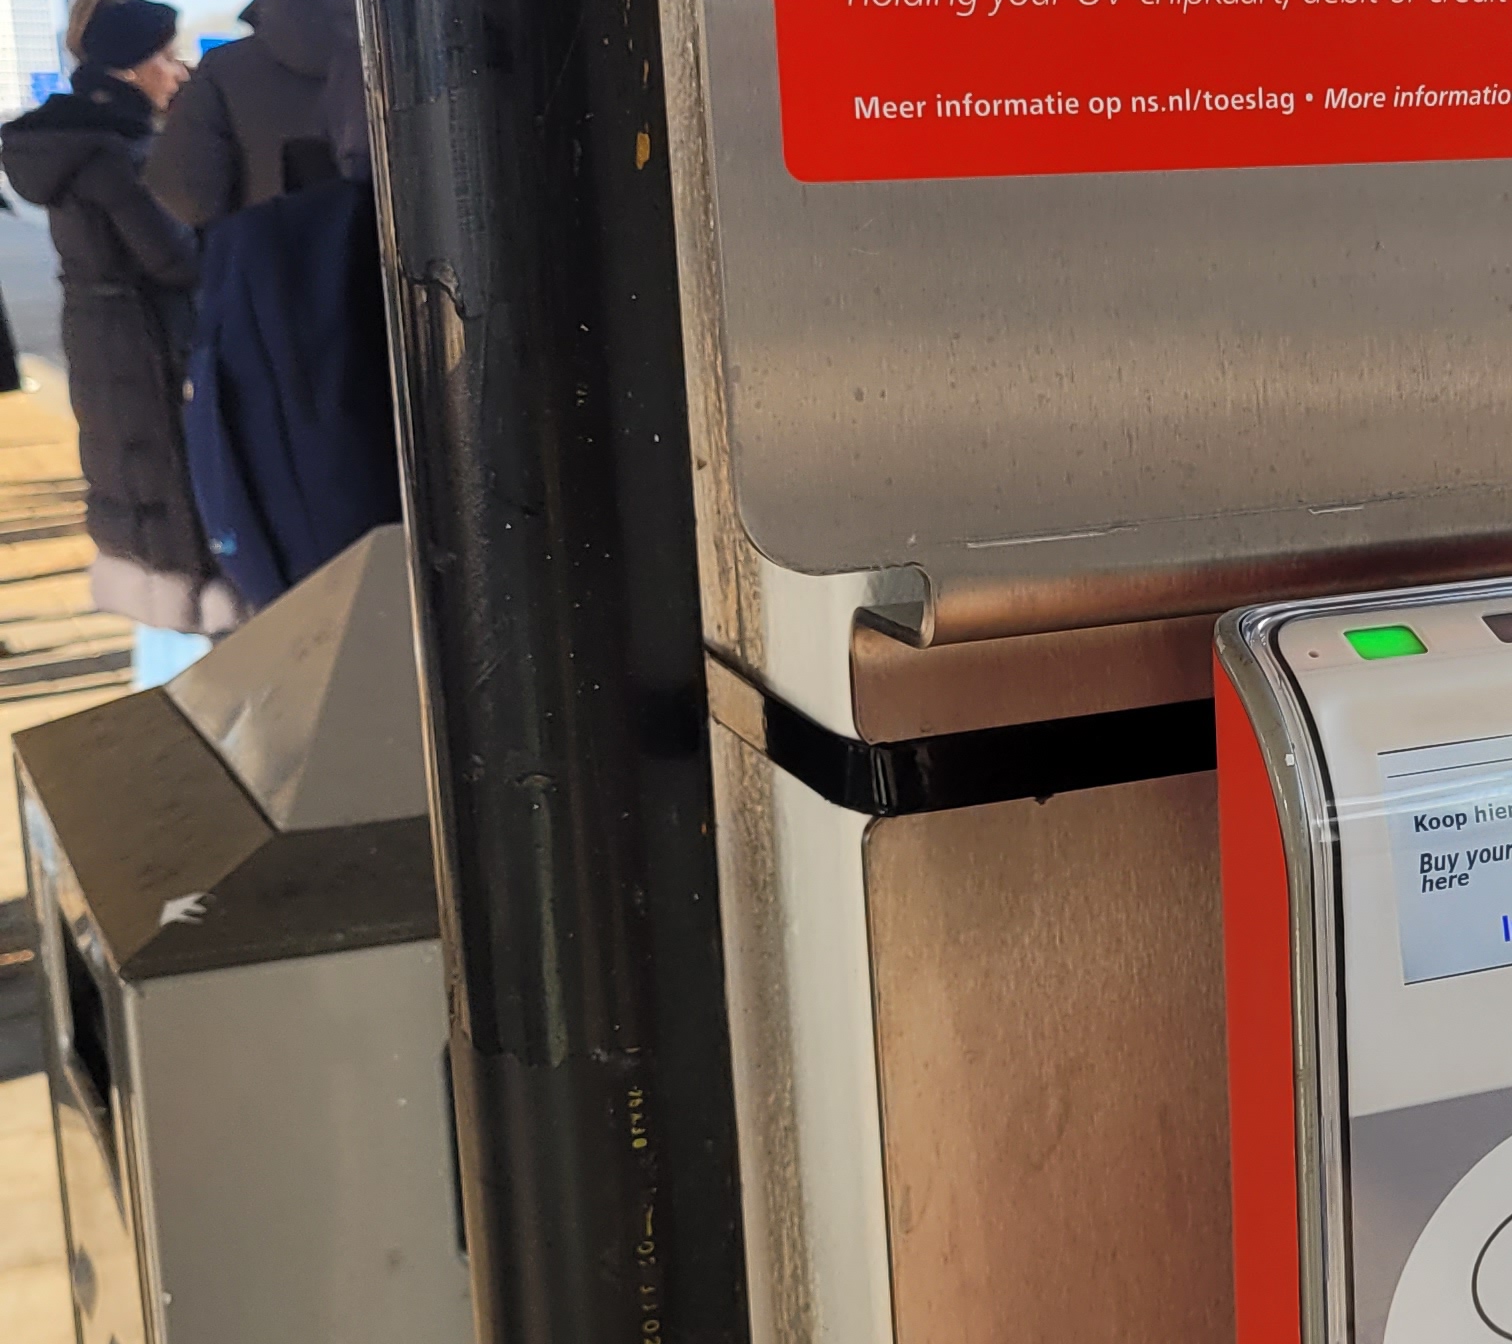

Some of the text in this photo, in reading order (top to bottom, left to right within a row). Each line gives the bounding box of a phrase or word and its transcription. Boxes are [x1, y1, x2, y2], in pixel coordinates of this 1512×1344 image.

[854, 96, 927, 120] Meer
[936, 92, 1080, 118] informatie
[1088, 96, 1122, 120] op
[1131, 86, 1295, 115] ns.nl/toeslag
[1324, 87, 1386, 109] More
[1413, 810, 1468, 833] Koop
[1419, 851, 1459, 875] Buy
[1420, 870, 1470, 894] here
